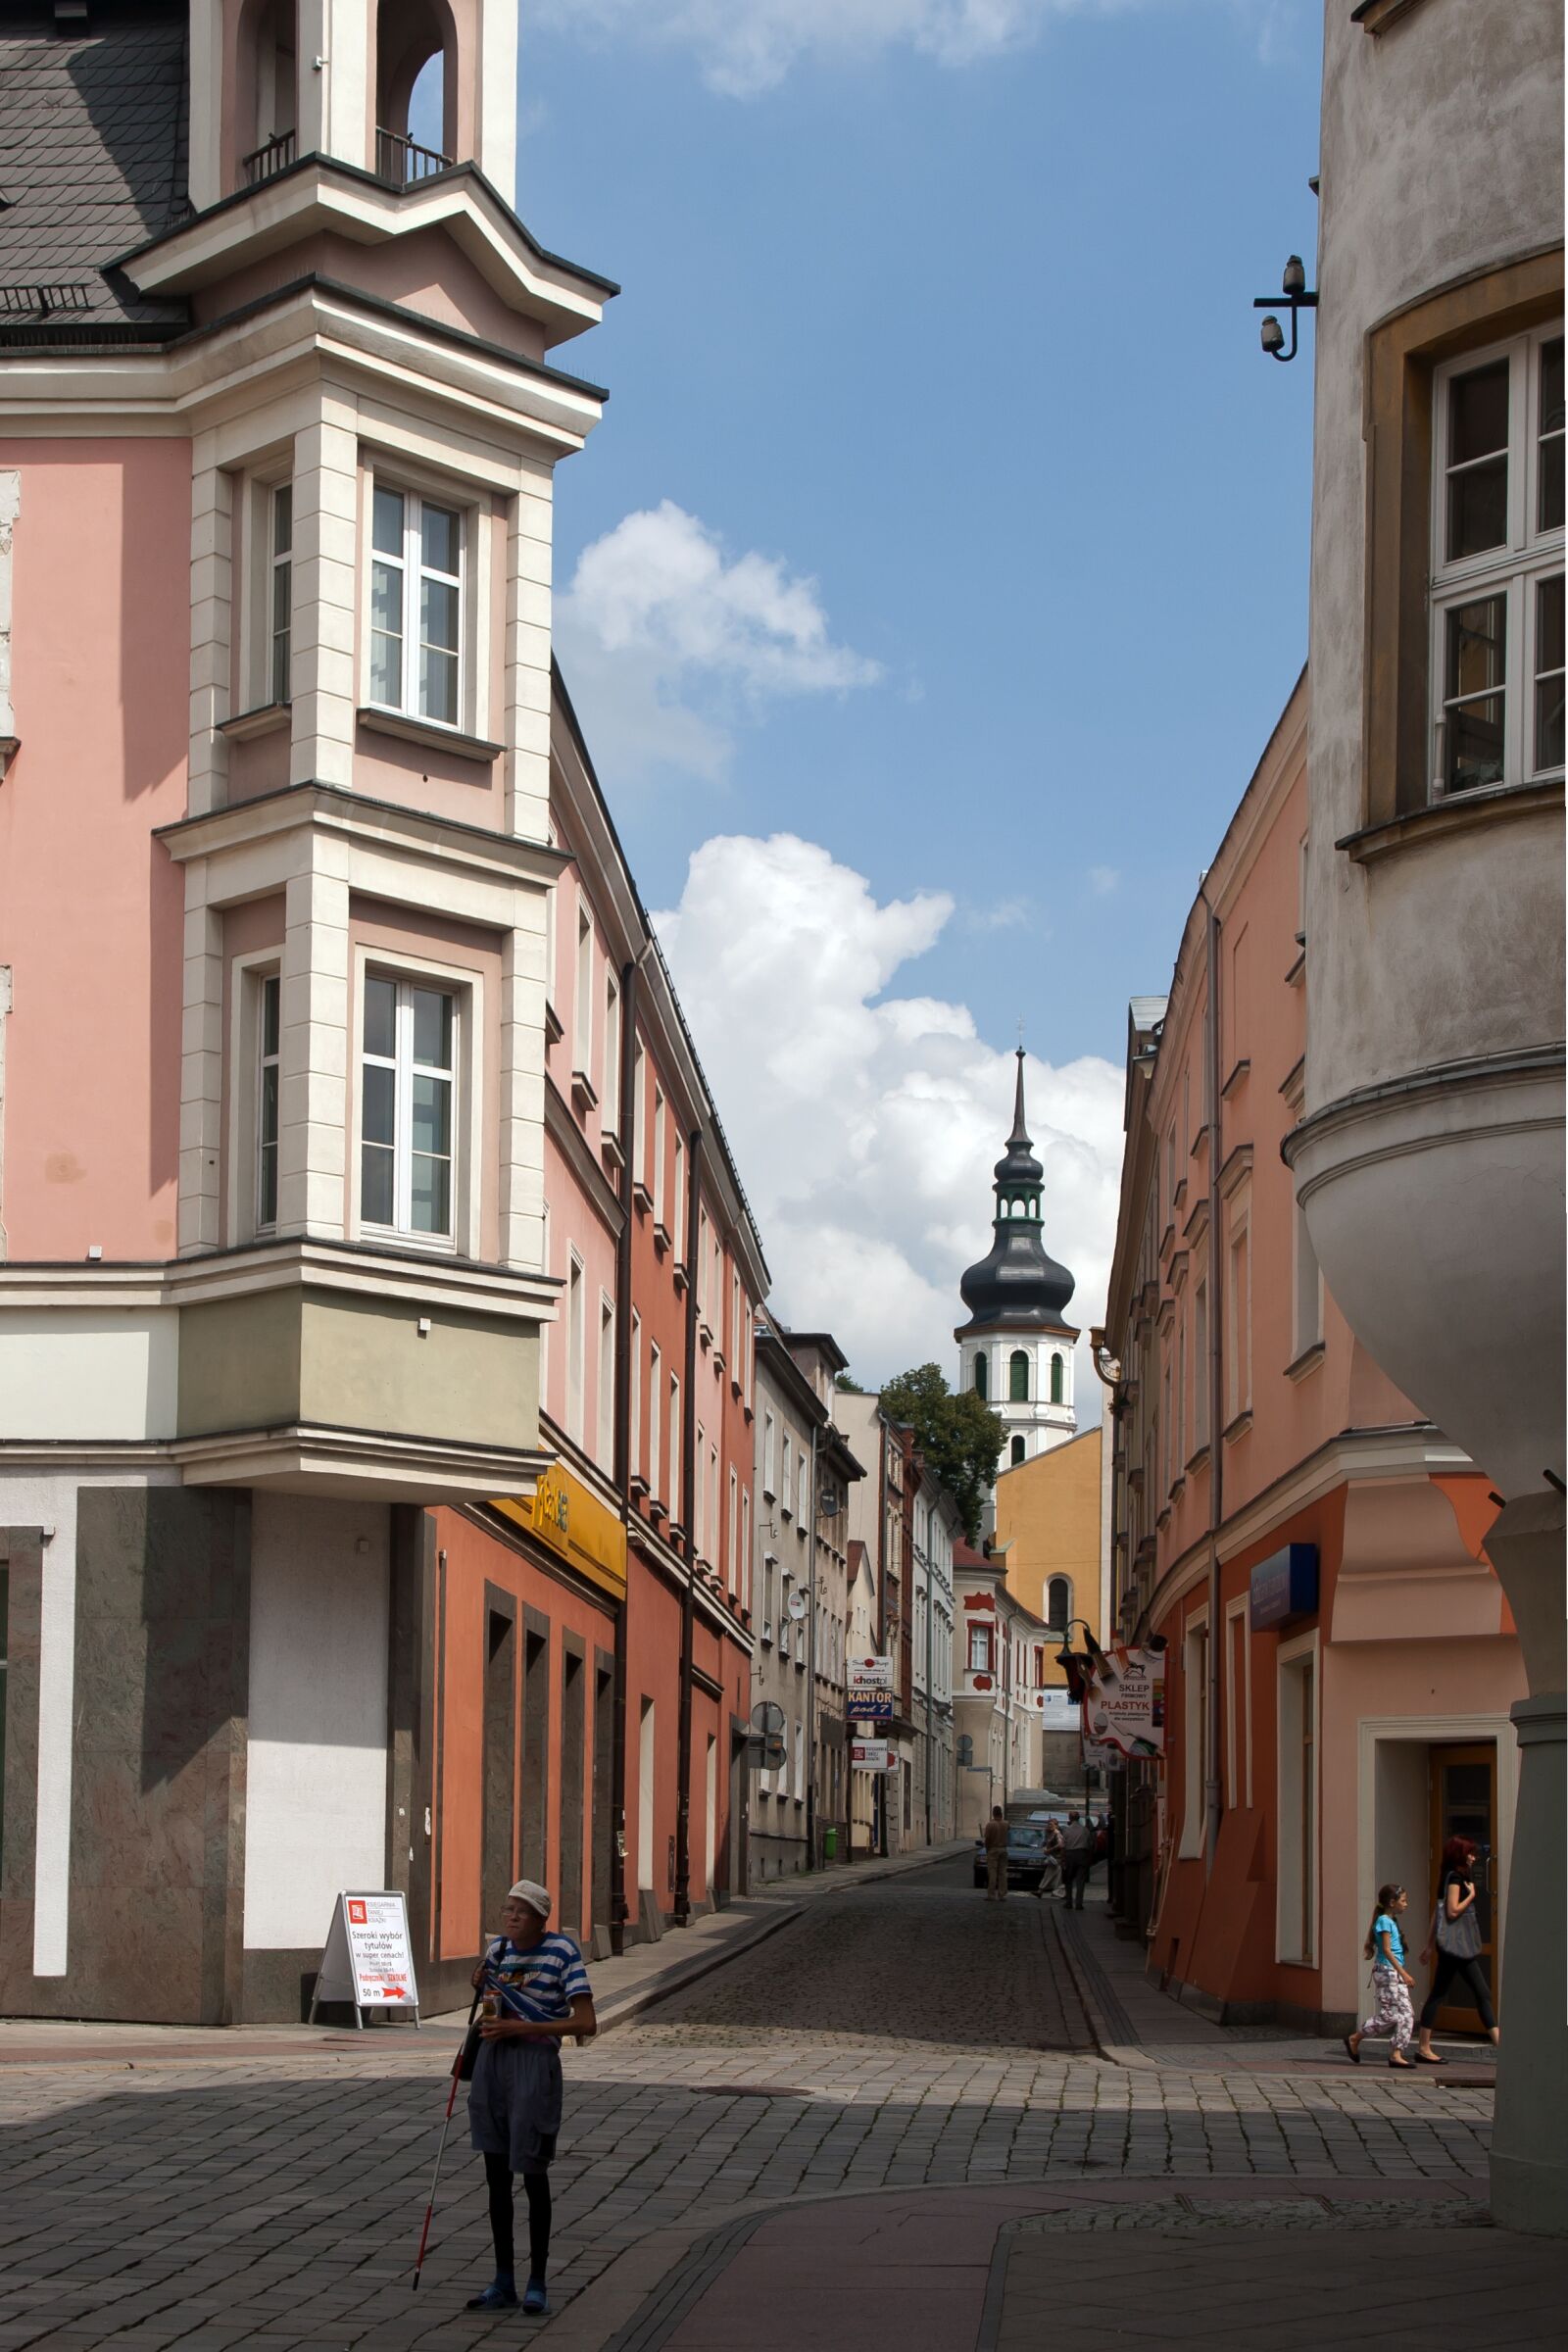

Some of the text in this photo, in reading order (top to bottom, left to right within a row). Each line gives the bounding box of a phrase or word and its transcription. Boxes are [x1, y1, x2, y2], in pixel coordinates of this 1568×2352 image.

[848, 1691, 892, 1702] KANTOR
[851, 1704, 876, 1714] pod
[1101, 1700, 1150, 1710] PLASTYK
[352, 1931, 403, 1941] Szeroki wybór
[365, 1941, 392, 1951] tytułów
